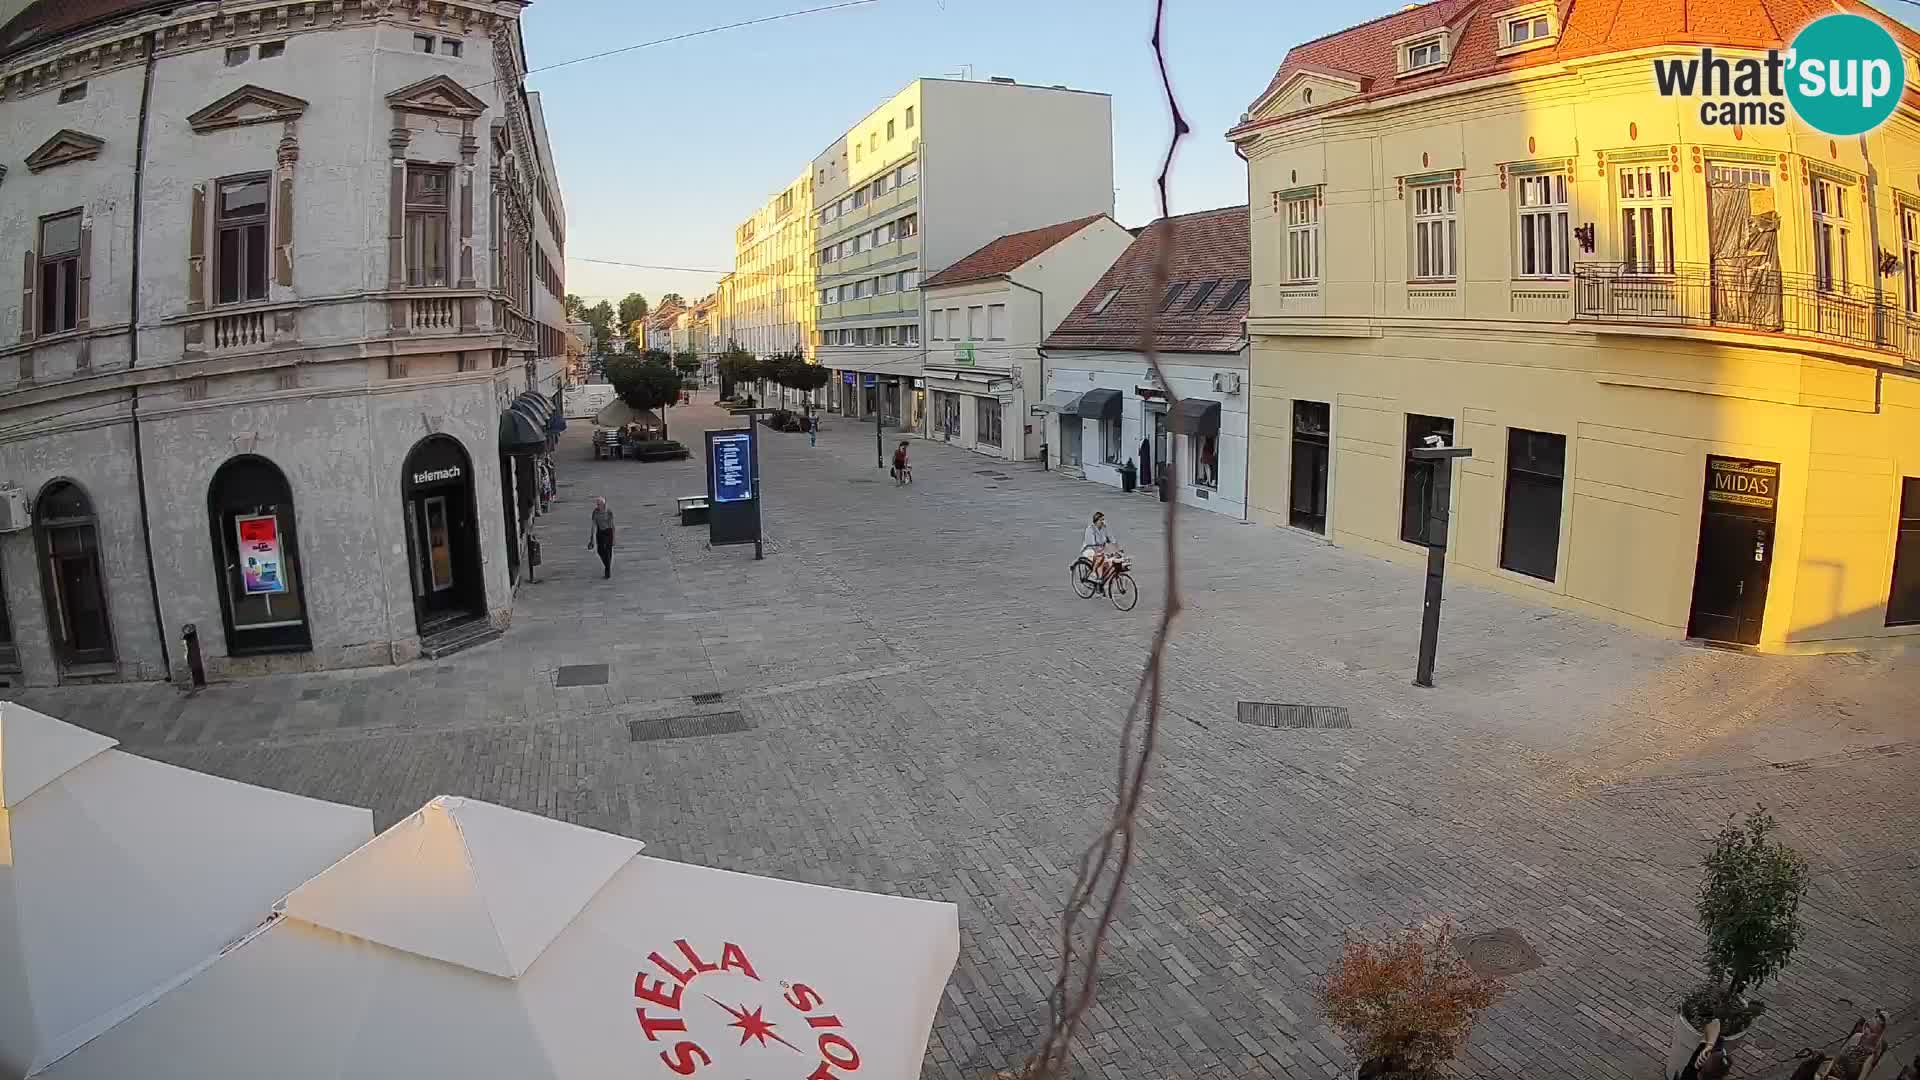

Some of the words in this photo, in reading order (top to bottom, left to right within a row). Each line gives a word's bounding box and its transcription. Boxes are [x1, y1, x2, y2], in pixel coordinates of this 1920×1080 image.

[414, 465, 460, 484] telemach
[1715, 472, 1769, 495] MIDAS
[634, 939, 761, 1076] STELLA
